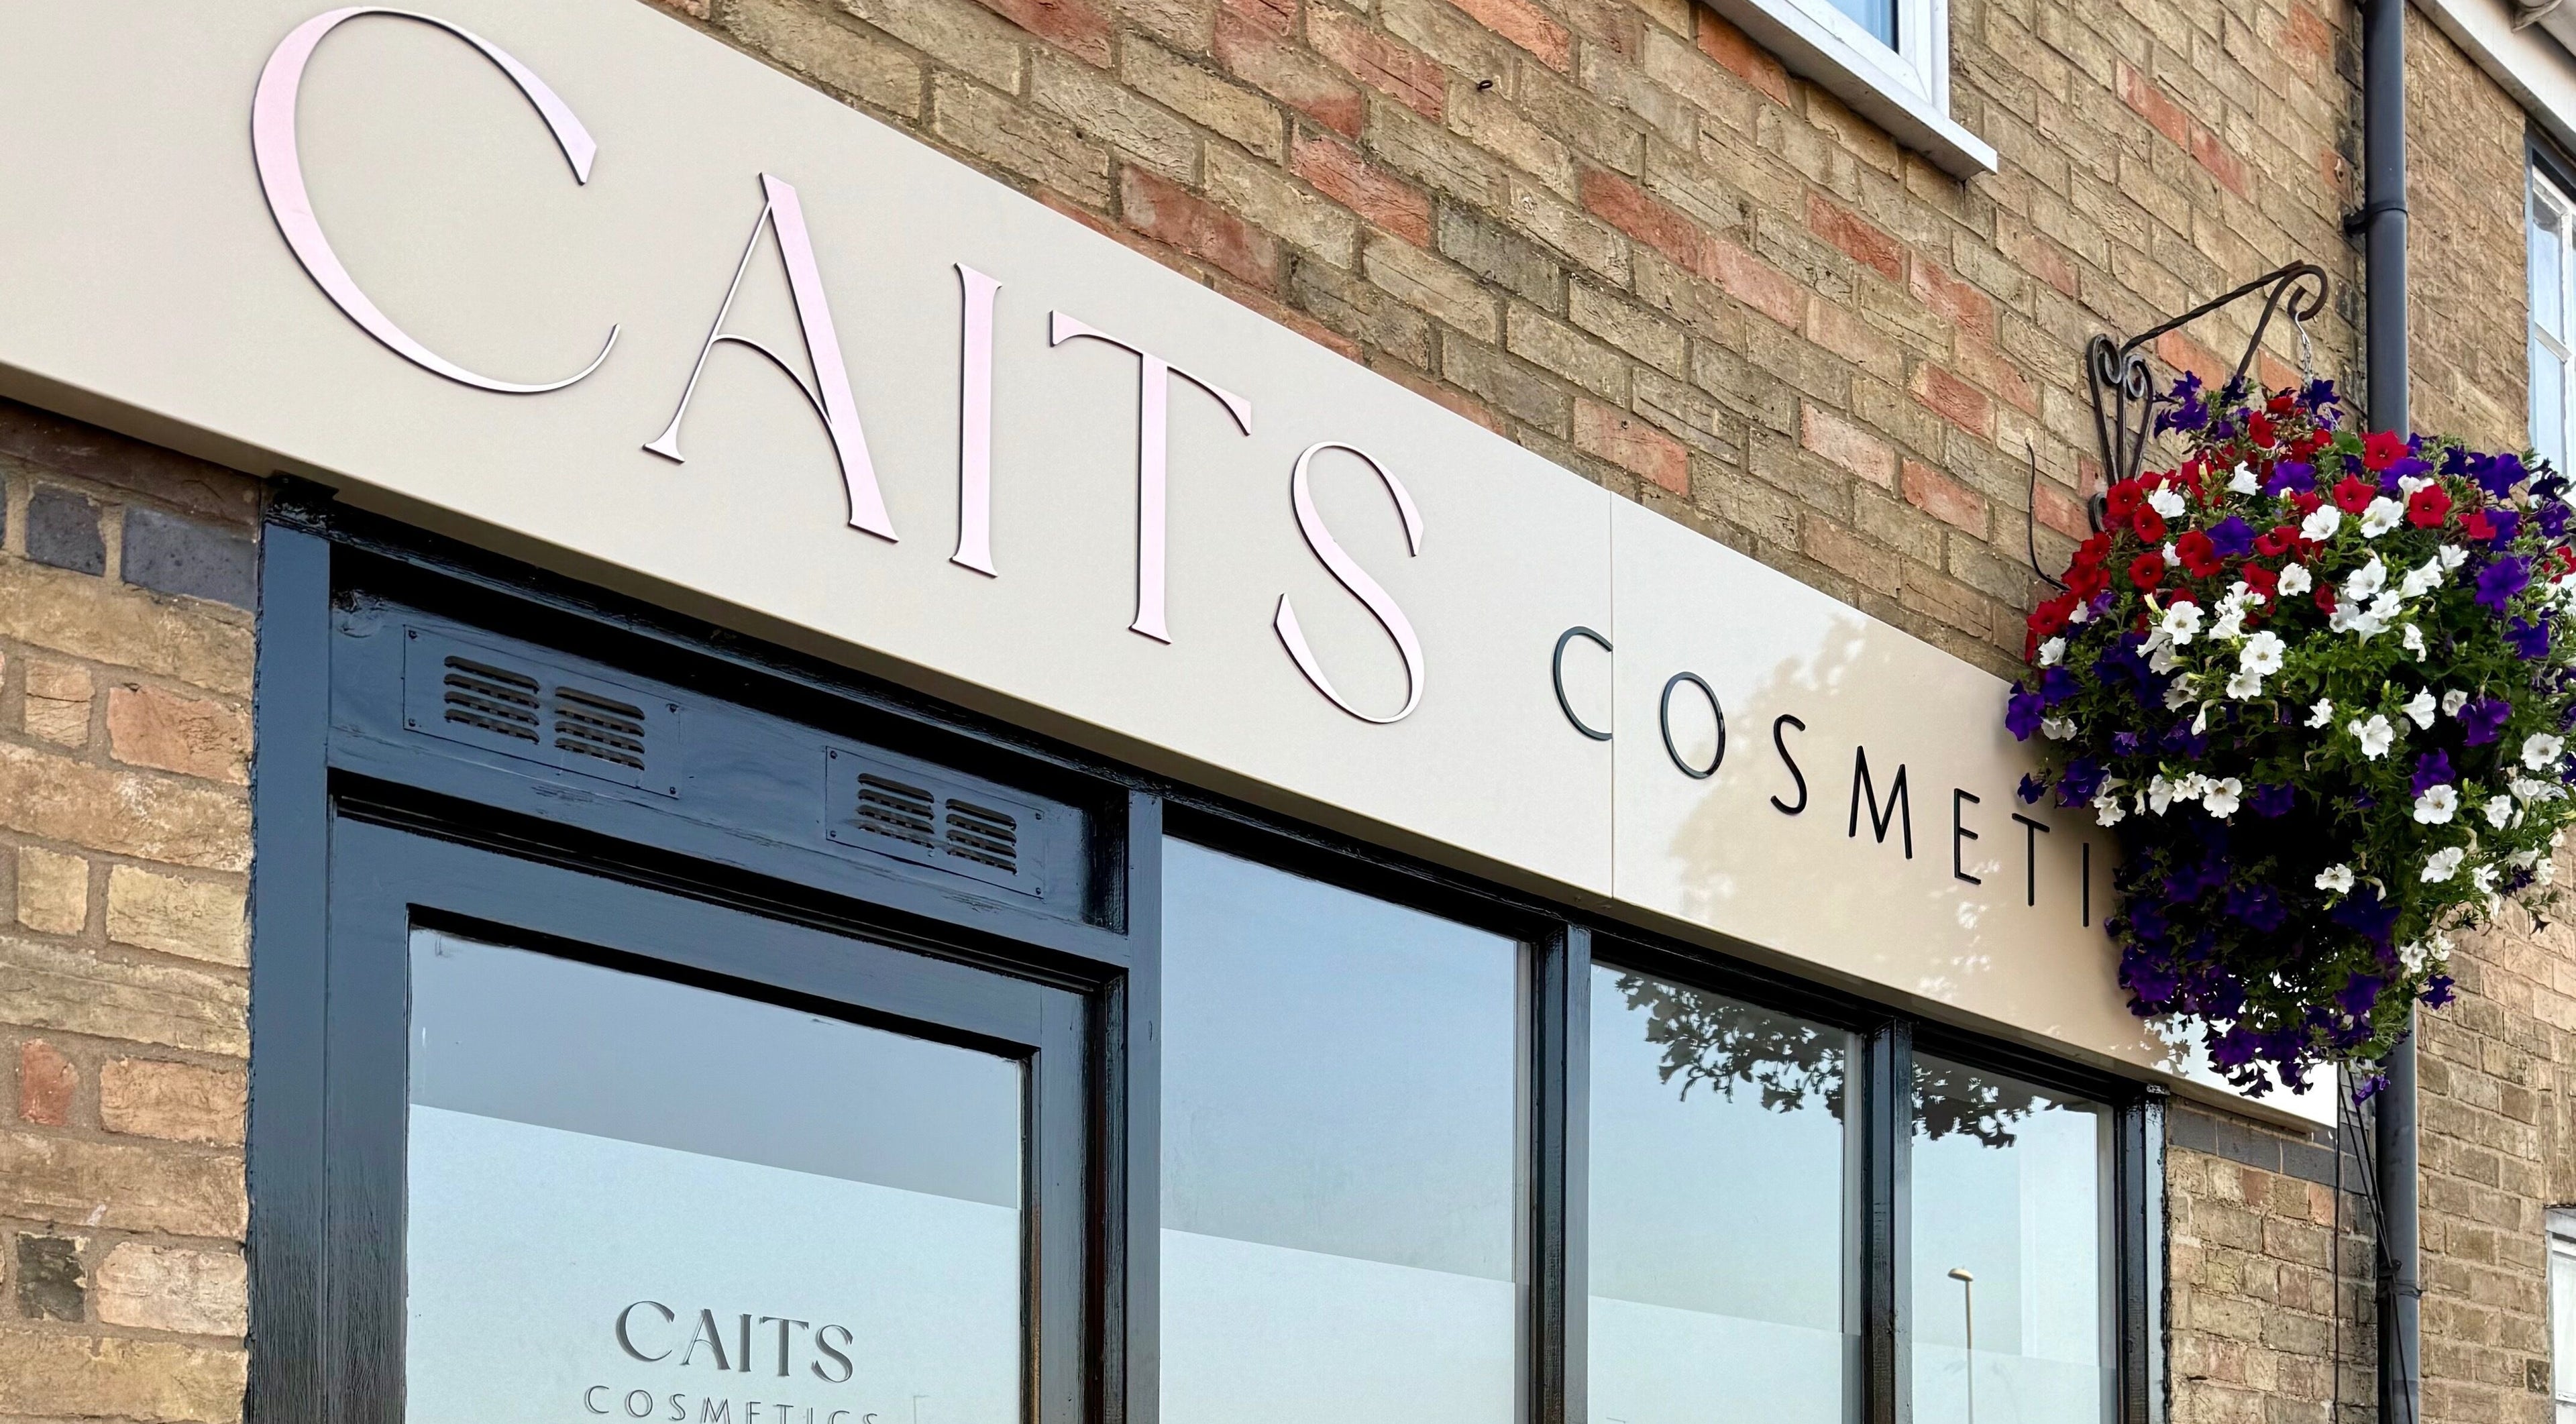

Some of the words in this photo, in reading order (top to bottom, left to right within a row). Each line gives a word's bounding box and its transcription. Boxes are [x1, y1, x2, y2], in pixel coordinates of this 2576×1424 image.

[250, 5, 1426, 726] CAITS
[1552, 625, 2090, 928] COSMETI
[616, 1300, 853, 1382] CAITS
